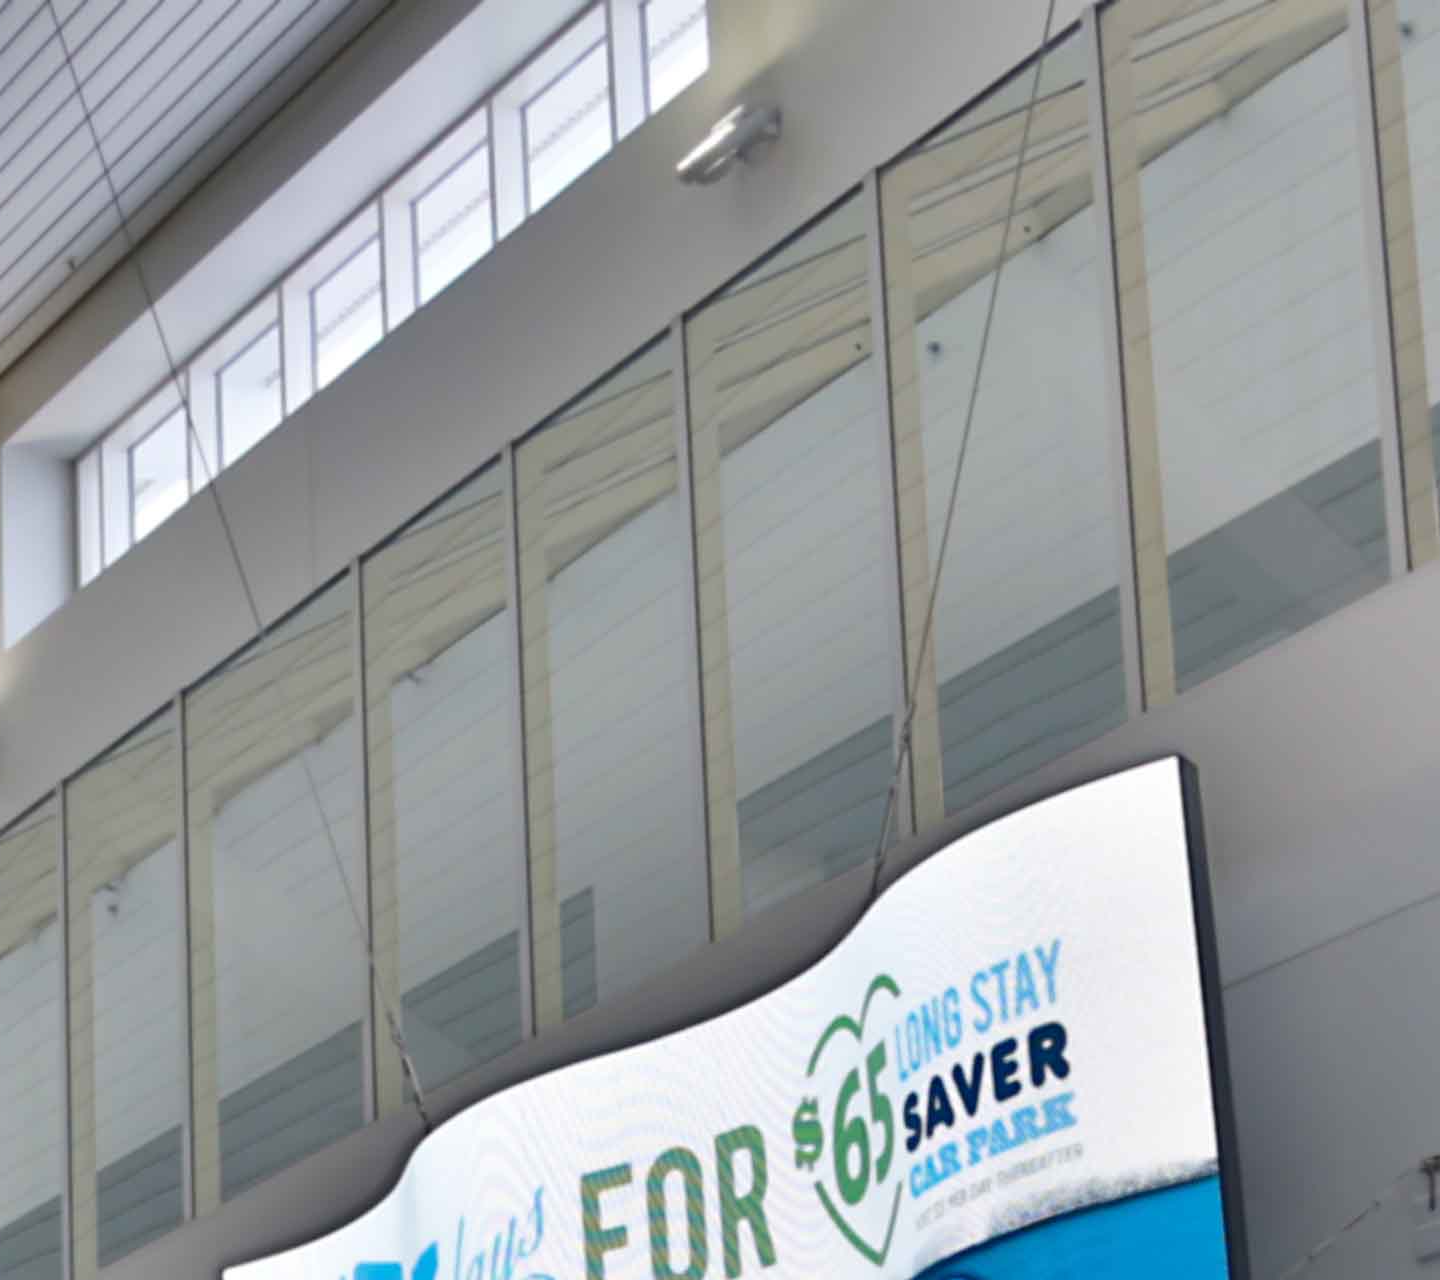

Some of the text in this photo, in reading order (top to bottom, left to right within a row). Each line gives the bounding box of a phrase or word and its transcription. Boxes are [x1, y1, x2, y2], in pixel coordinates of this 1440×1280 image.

[894, 938, 1062, 1083] LONG STAY
[902, 1020, 1071, 1153] SAVER
[908, 1090, 1078, 1199] CAR PARK
